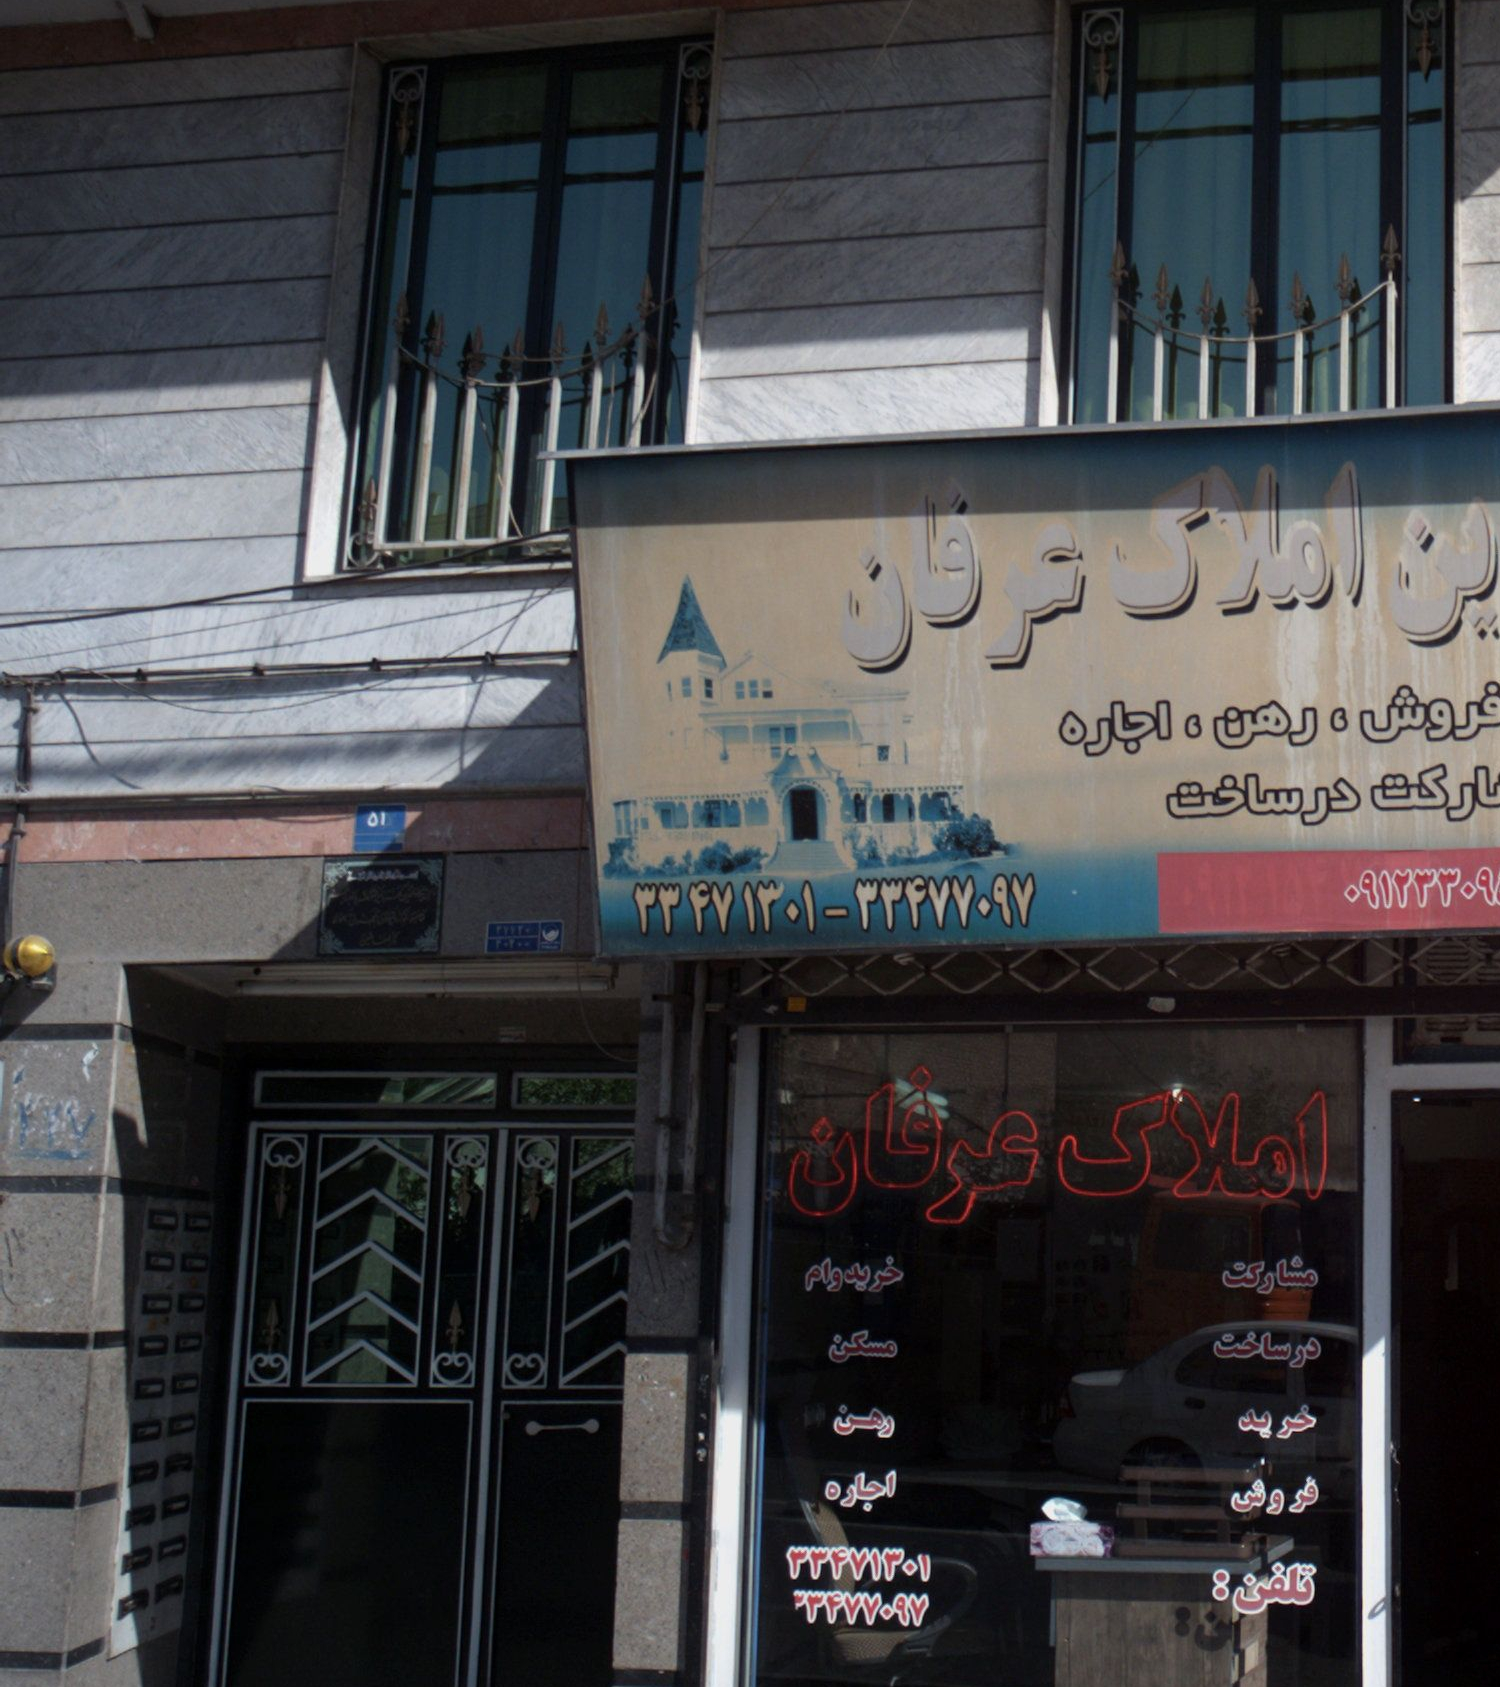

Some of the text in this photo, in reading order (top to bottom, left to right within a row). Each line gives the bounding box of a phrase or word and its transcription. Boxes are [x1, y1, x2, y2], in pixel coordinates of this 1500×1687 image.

[1109, 461, 1364, 619] املاک
[842, 478, 1086, 674] عرفان
[1059, 700, 1172, 756] اجاره
[1213, 699, 1318, 750] رهن
[367, 811, 386, 828] ۵۱
[789, 1066, 1328, 1223] املاک عرفان
[1221, 1255, 1319, 1294] مشارکت
[828, 1328, 898, 1363] مسکن
[832, 1404, 896, 1438] رهن
[1238, 1404, 1318, 1440] خرید
[824, 1469, 897, 1513] اجاره
[1230, 1474, 1320, 1516] فروش
[786, 1543, 932, 1583] ۳۳۴۷۱۳۰۱
